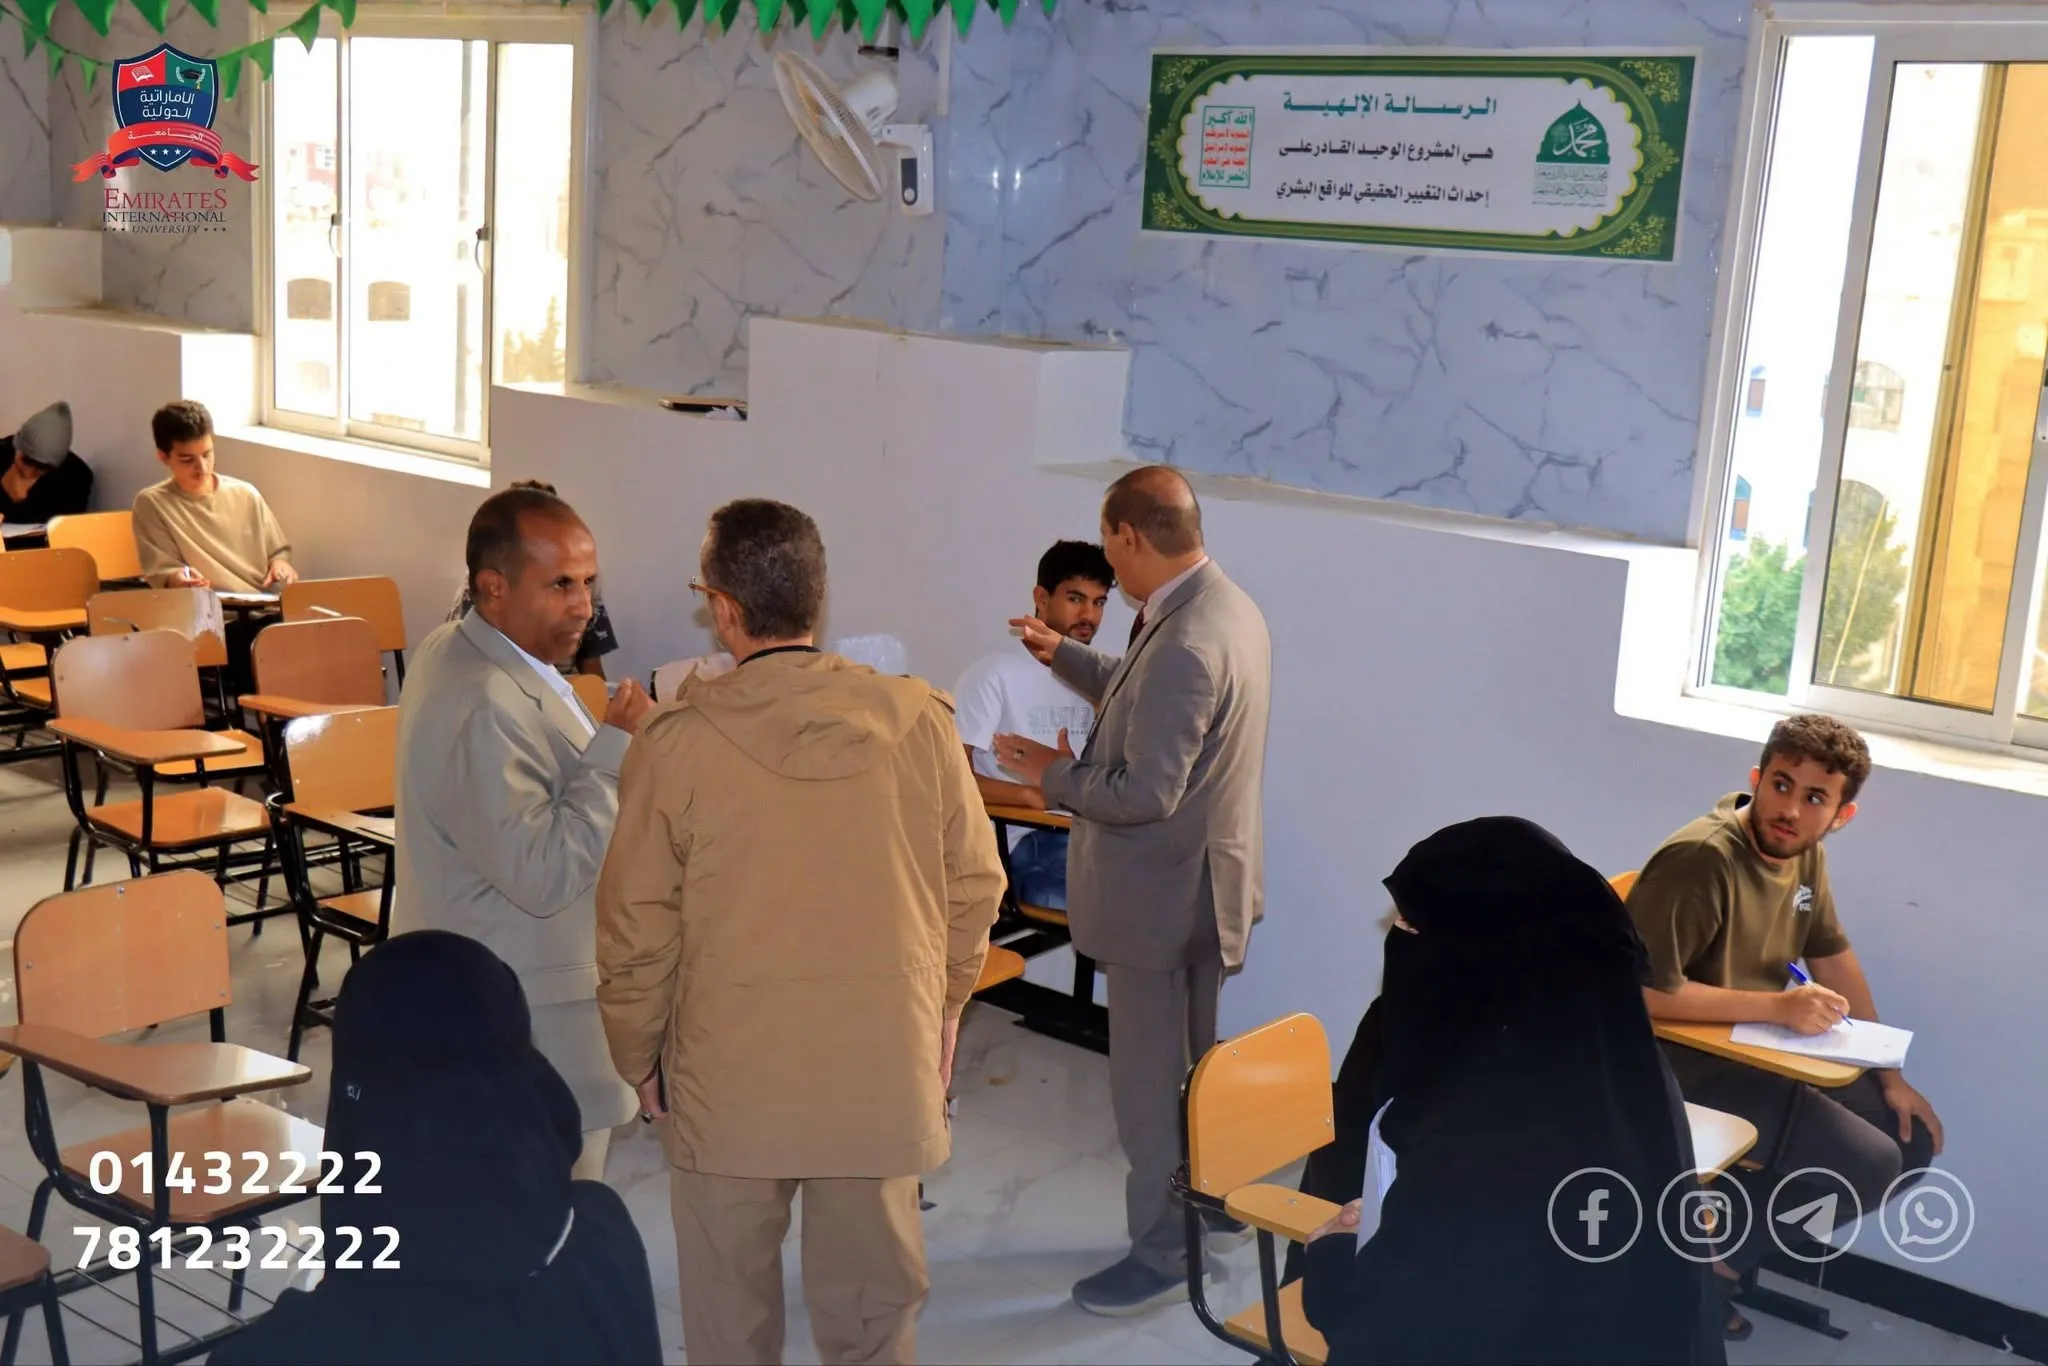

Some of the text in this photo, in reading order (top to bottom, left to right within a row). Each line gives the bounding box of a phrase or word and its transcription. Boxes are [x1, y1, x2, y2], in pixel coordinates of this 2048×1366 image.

[1384, 92, 1498, 120] الرسالة
[1312, 139, 1356, 157] القادر
[1357, 141, 1406, 160] الوحيد
[1407, 140, 1460, 162] المشروع
[1462, 145, 1494, 166] هي
[1276, 178, 1317, 199] البشري
[1318, 179, 1353, 202] للواقع
[1354, 182, 1403, 204] الحقيقي
[1403, 183, 1446, 204] التغيير
